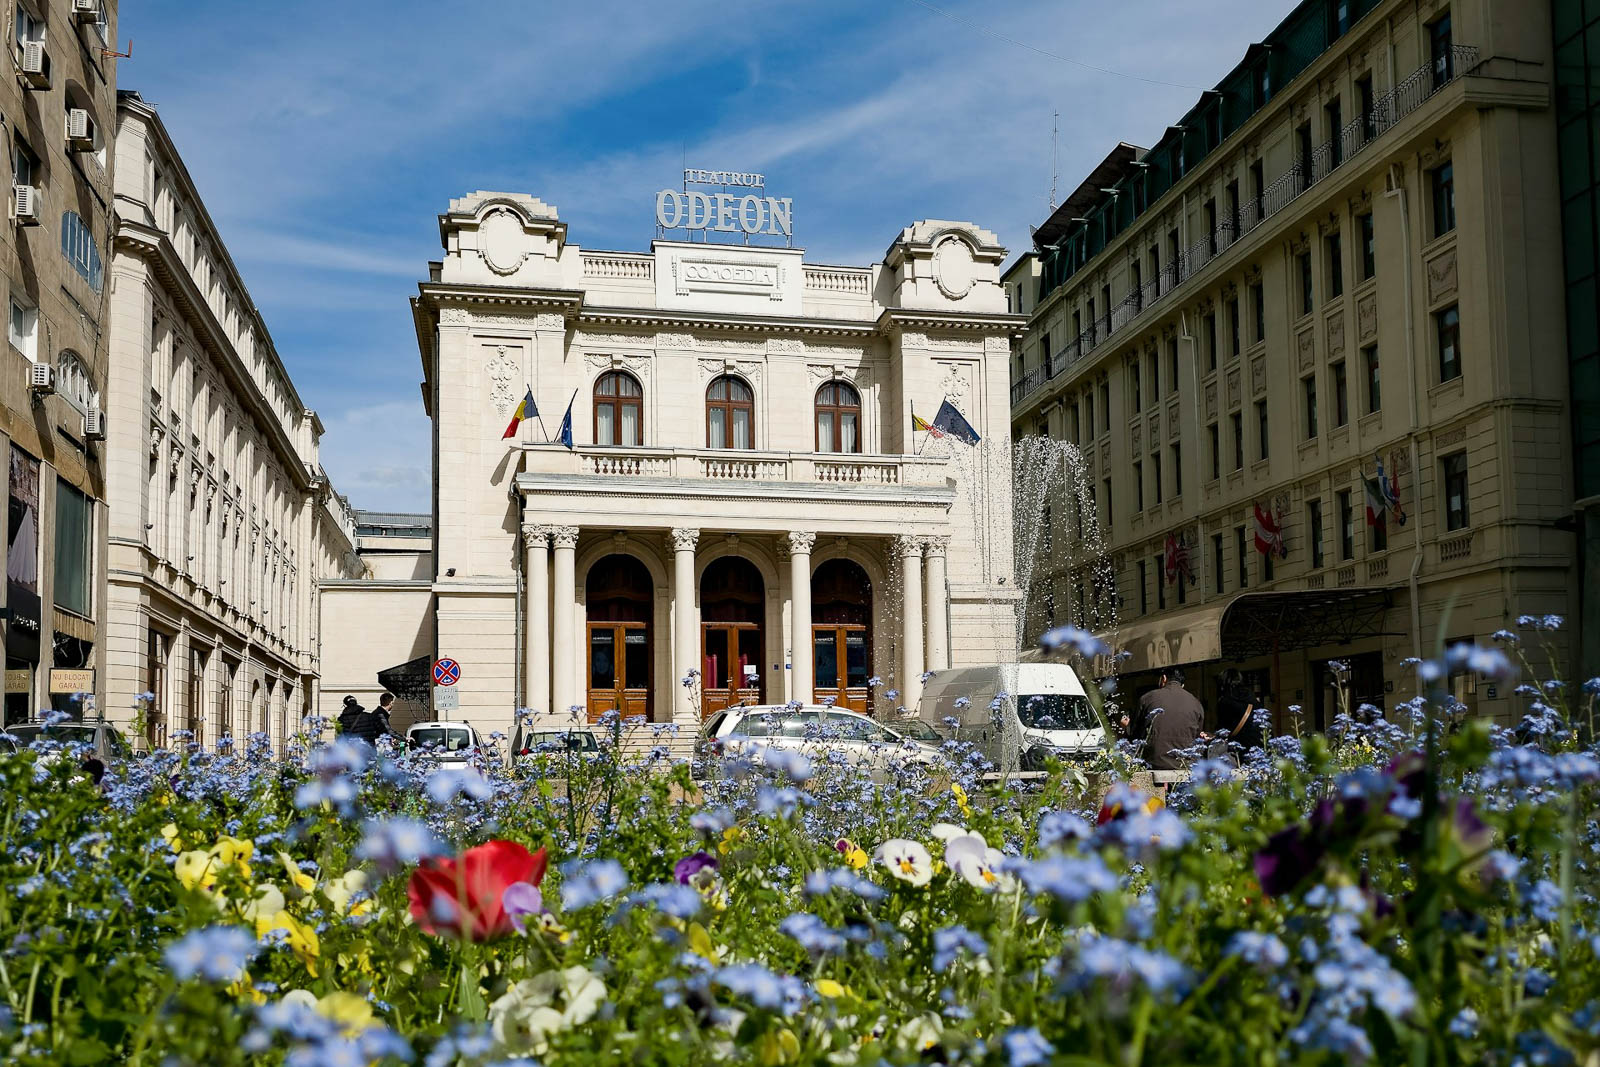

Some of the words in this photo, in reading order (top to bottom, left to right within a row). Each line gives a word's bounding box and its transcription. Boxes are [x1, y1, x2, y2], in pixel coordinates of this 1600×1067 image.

[686, 169, 764, 186] TEATRUL
[656, 188, 792, 236] ODEON
[686, 266, 772, 282] COMOEDIA
